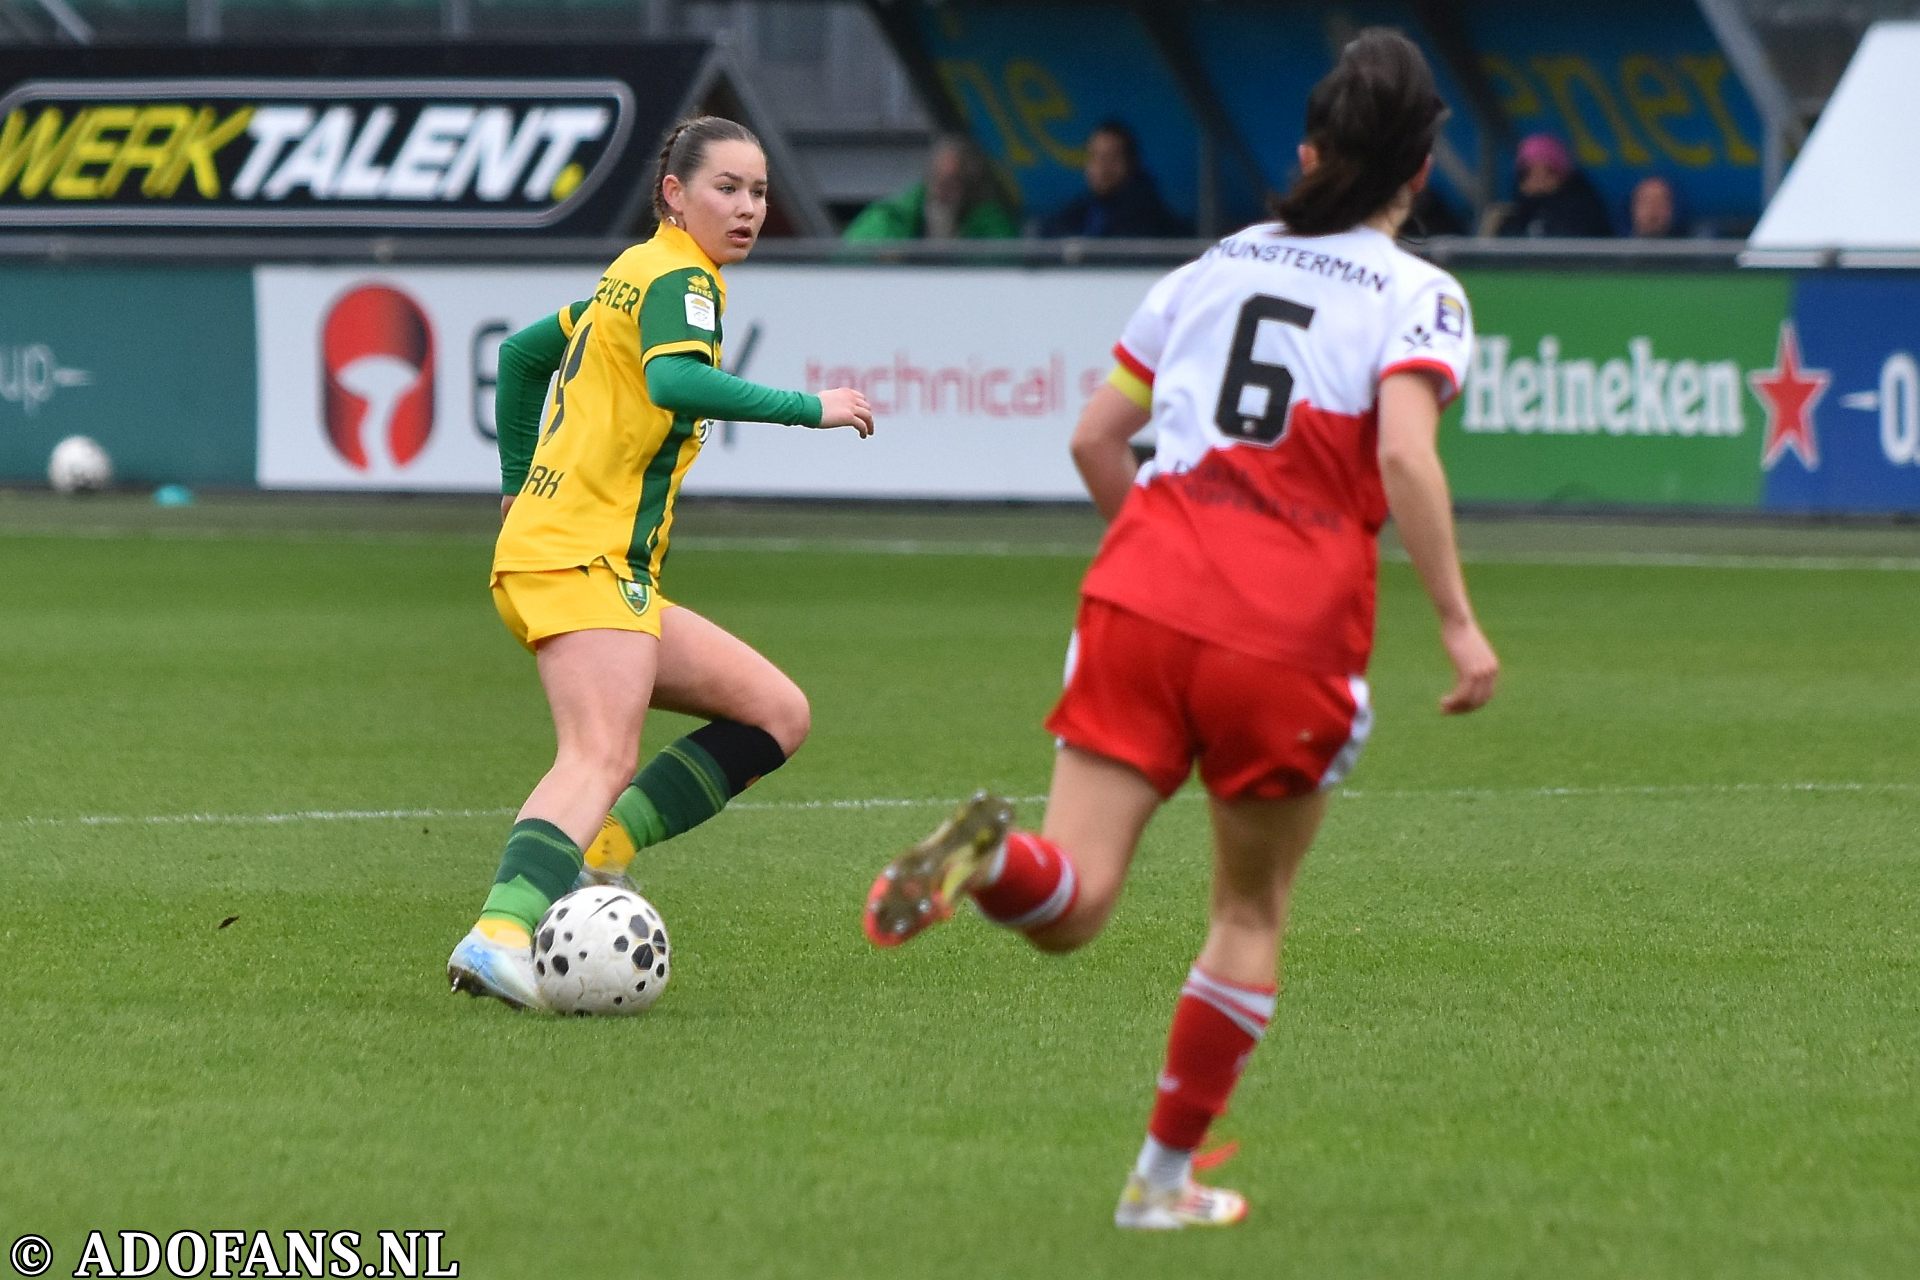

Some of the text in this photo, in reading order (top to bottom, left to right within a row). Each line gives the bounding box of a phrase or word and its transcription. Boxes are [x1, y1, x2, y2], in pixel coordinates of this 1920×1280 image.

[1206, 239, 1390, 293] MUNSTERMAN
[1214, 292, 1316, 447] 6
[1460, 334, 1746, 437] Heineken
